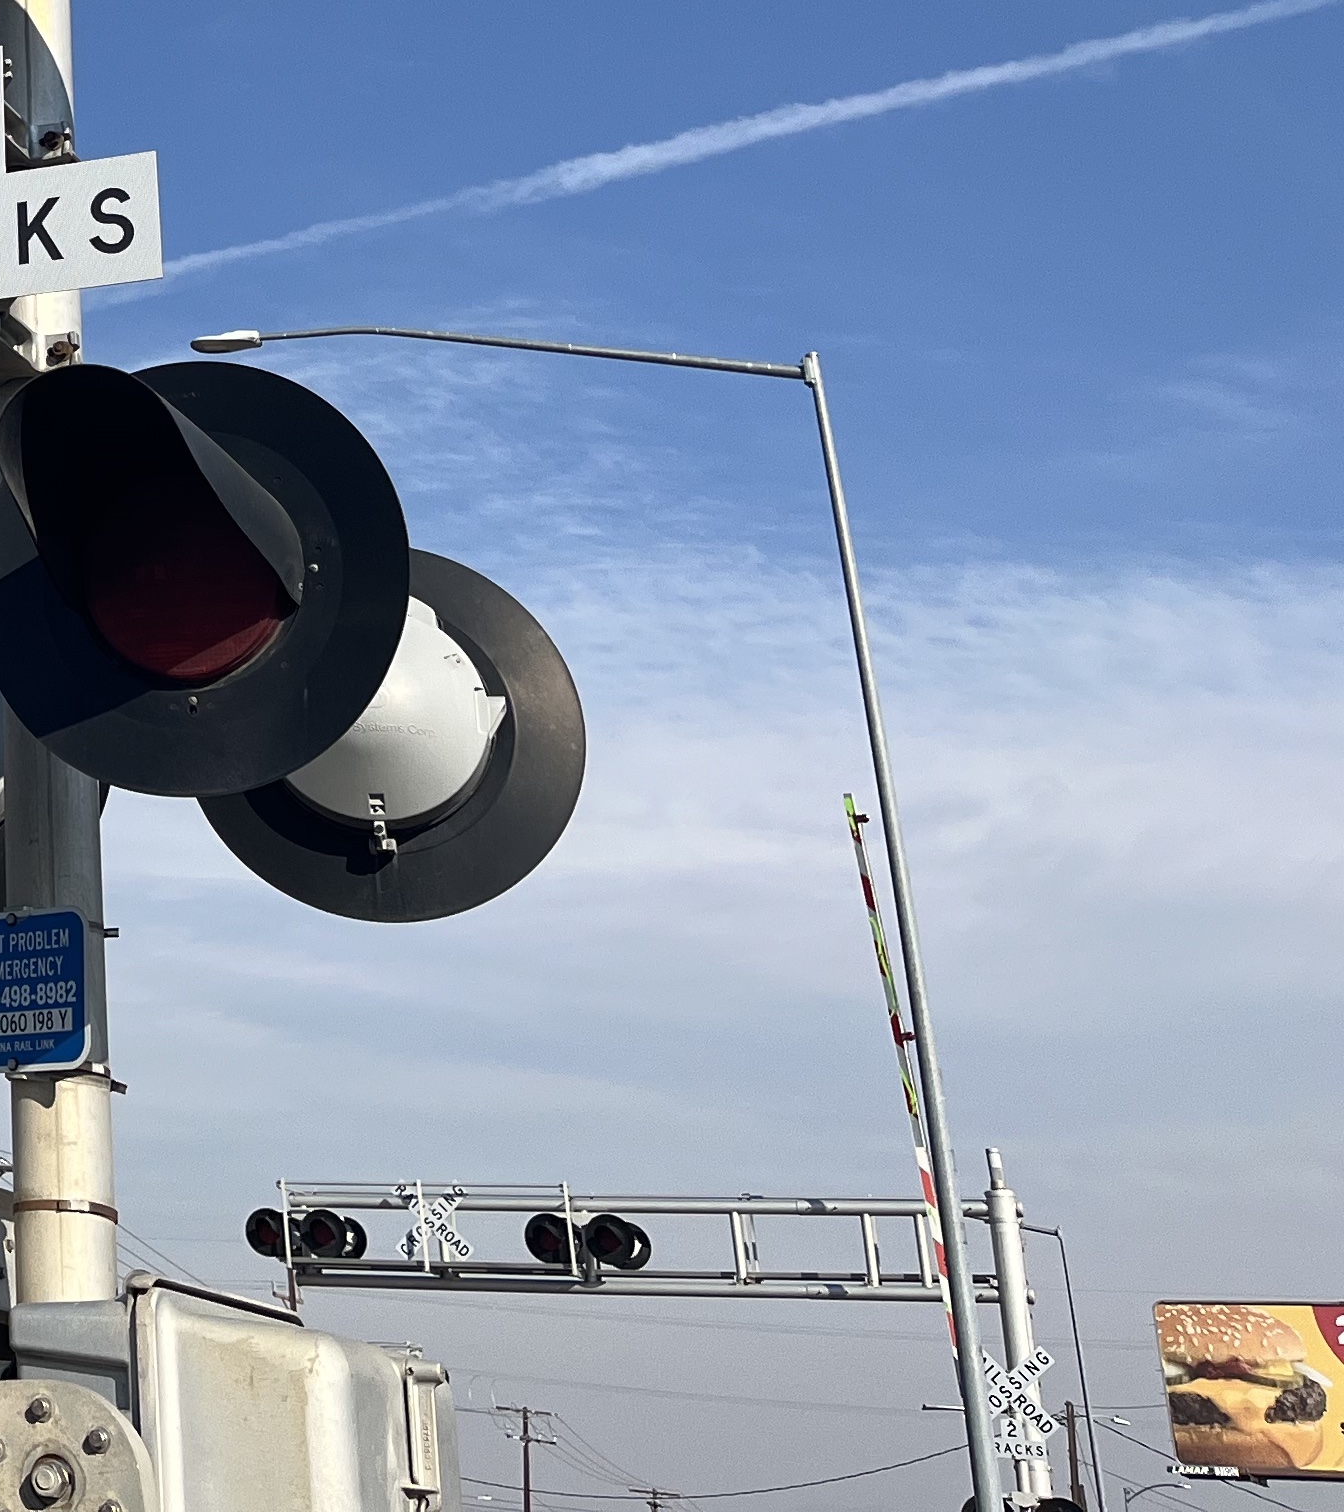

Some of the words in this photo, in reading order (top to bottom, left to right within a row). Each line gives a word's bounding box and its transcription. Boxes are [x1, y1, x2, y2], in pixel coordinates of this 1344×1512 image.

[9, 928, 69, 952] PROBLEM
[0, 1013, 27, 1033] 060
[32, 1011, 54, 1032] 198
[58, 1009, 69, 1029] Y
[14, 1040, 34, 1051] RAIL
[35, 1038, 55, 1051] LINK
[436, 1223, 470, 1257] ROAD
[986, 1351, 1050, 1414] OSSING
[1012, 1393, 1054, 1434] ROAD
[1006, 1421, 1018, 1438] 2
[994, 1441, 1044, 1457] RACKS
